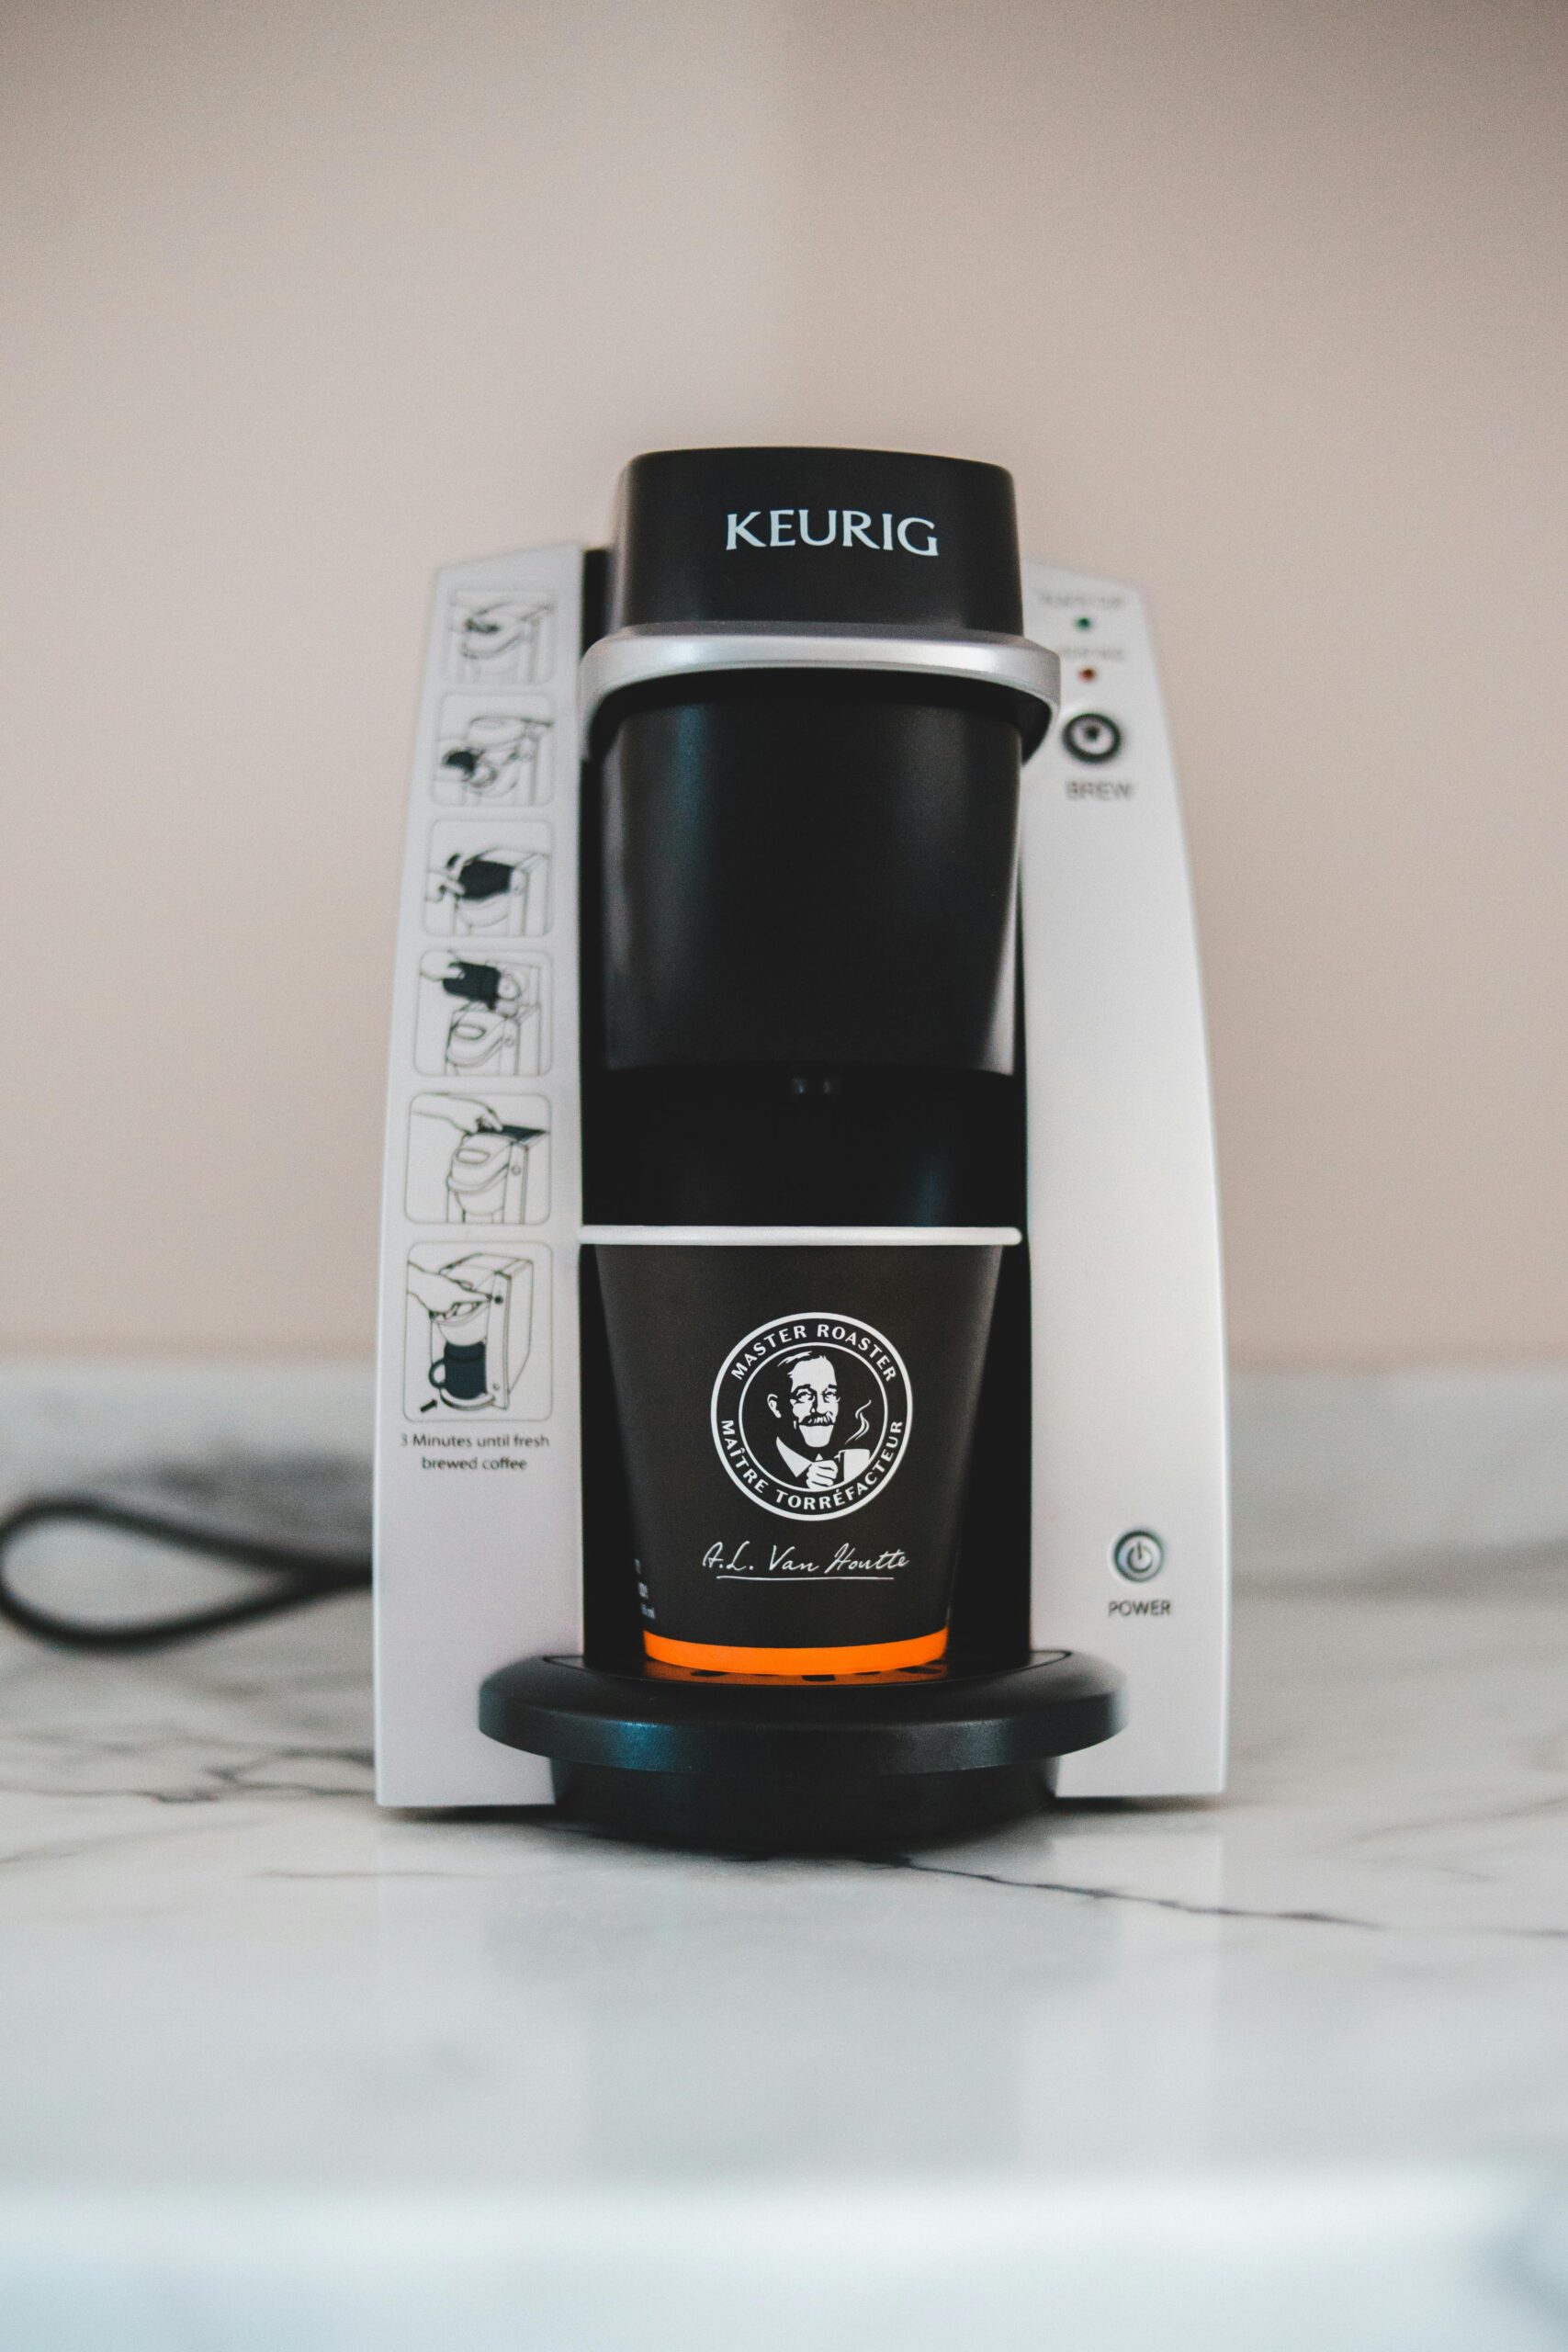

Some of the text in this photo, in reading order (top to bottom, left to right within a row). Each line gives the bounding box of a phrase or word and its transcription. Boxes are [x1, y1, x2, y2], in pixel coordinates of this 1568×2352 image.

[726, 509, 939, 557] KEURIG
[1066, 780, 1134, 801] BREW
[730, 1323, 897, 1382] MASTER ROASTER
[400, 1433, 550, 1448] 3 Minutes until fresh
[422, 1457, 528, 1470] brewed coffee
[720, 1419, 903, 1510] MAÎTRE TORRÉFACTEUR
[769, 1544, 820, 1572] Van
[824, 1543, 910, 1574] Houtte
[1108, 1600, 1171, 1617] POWER
